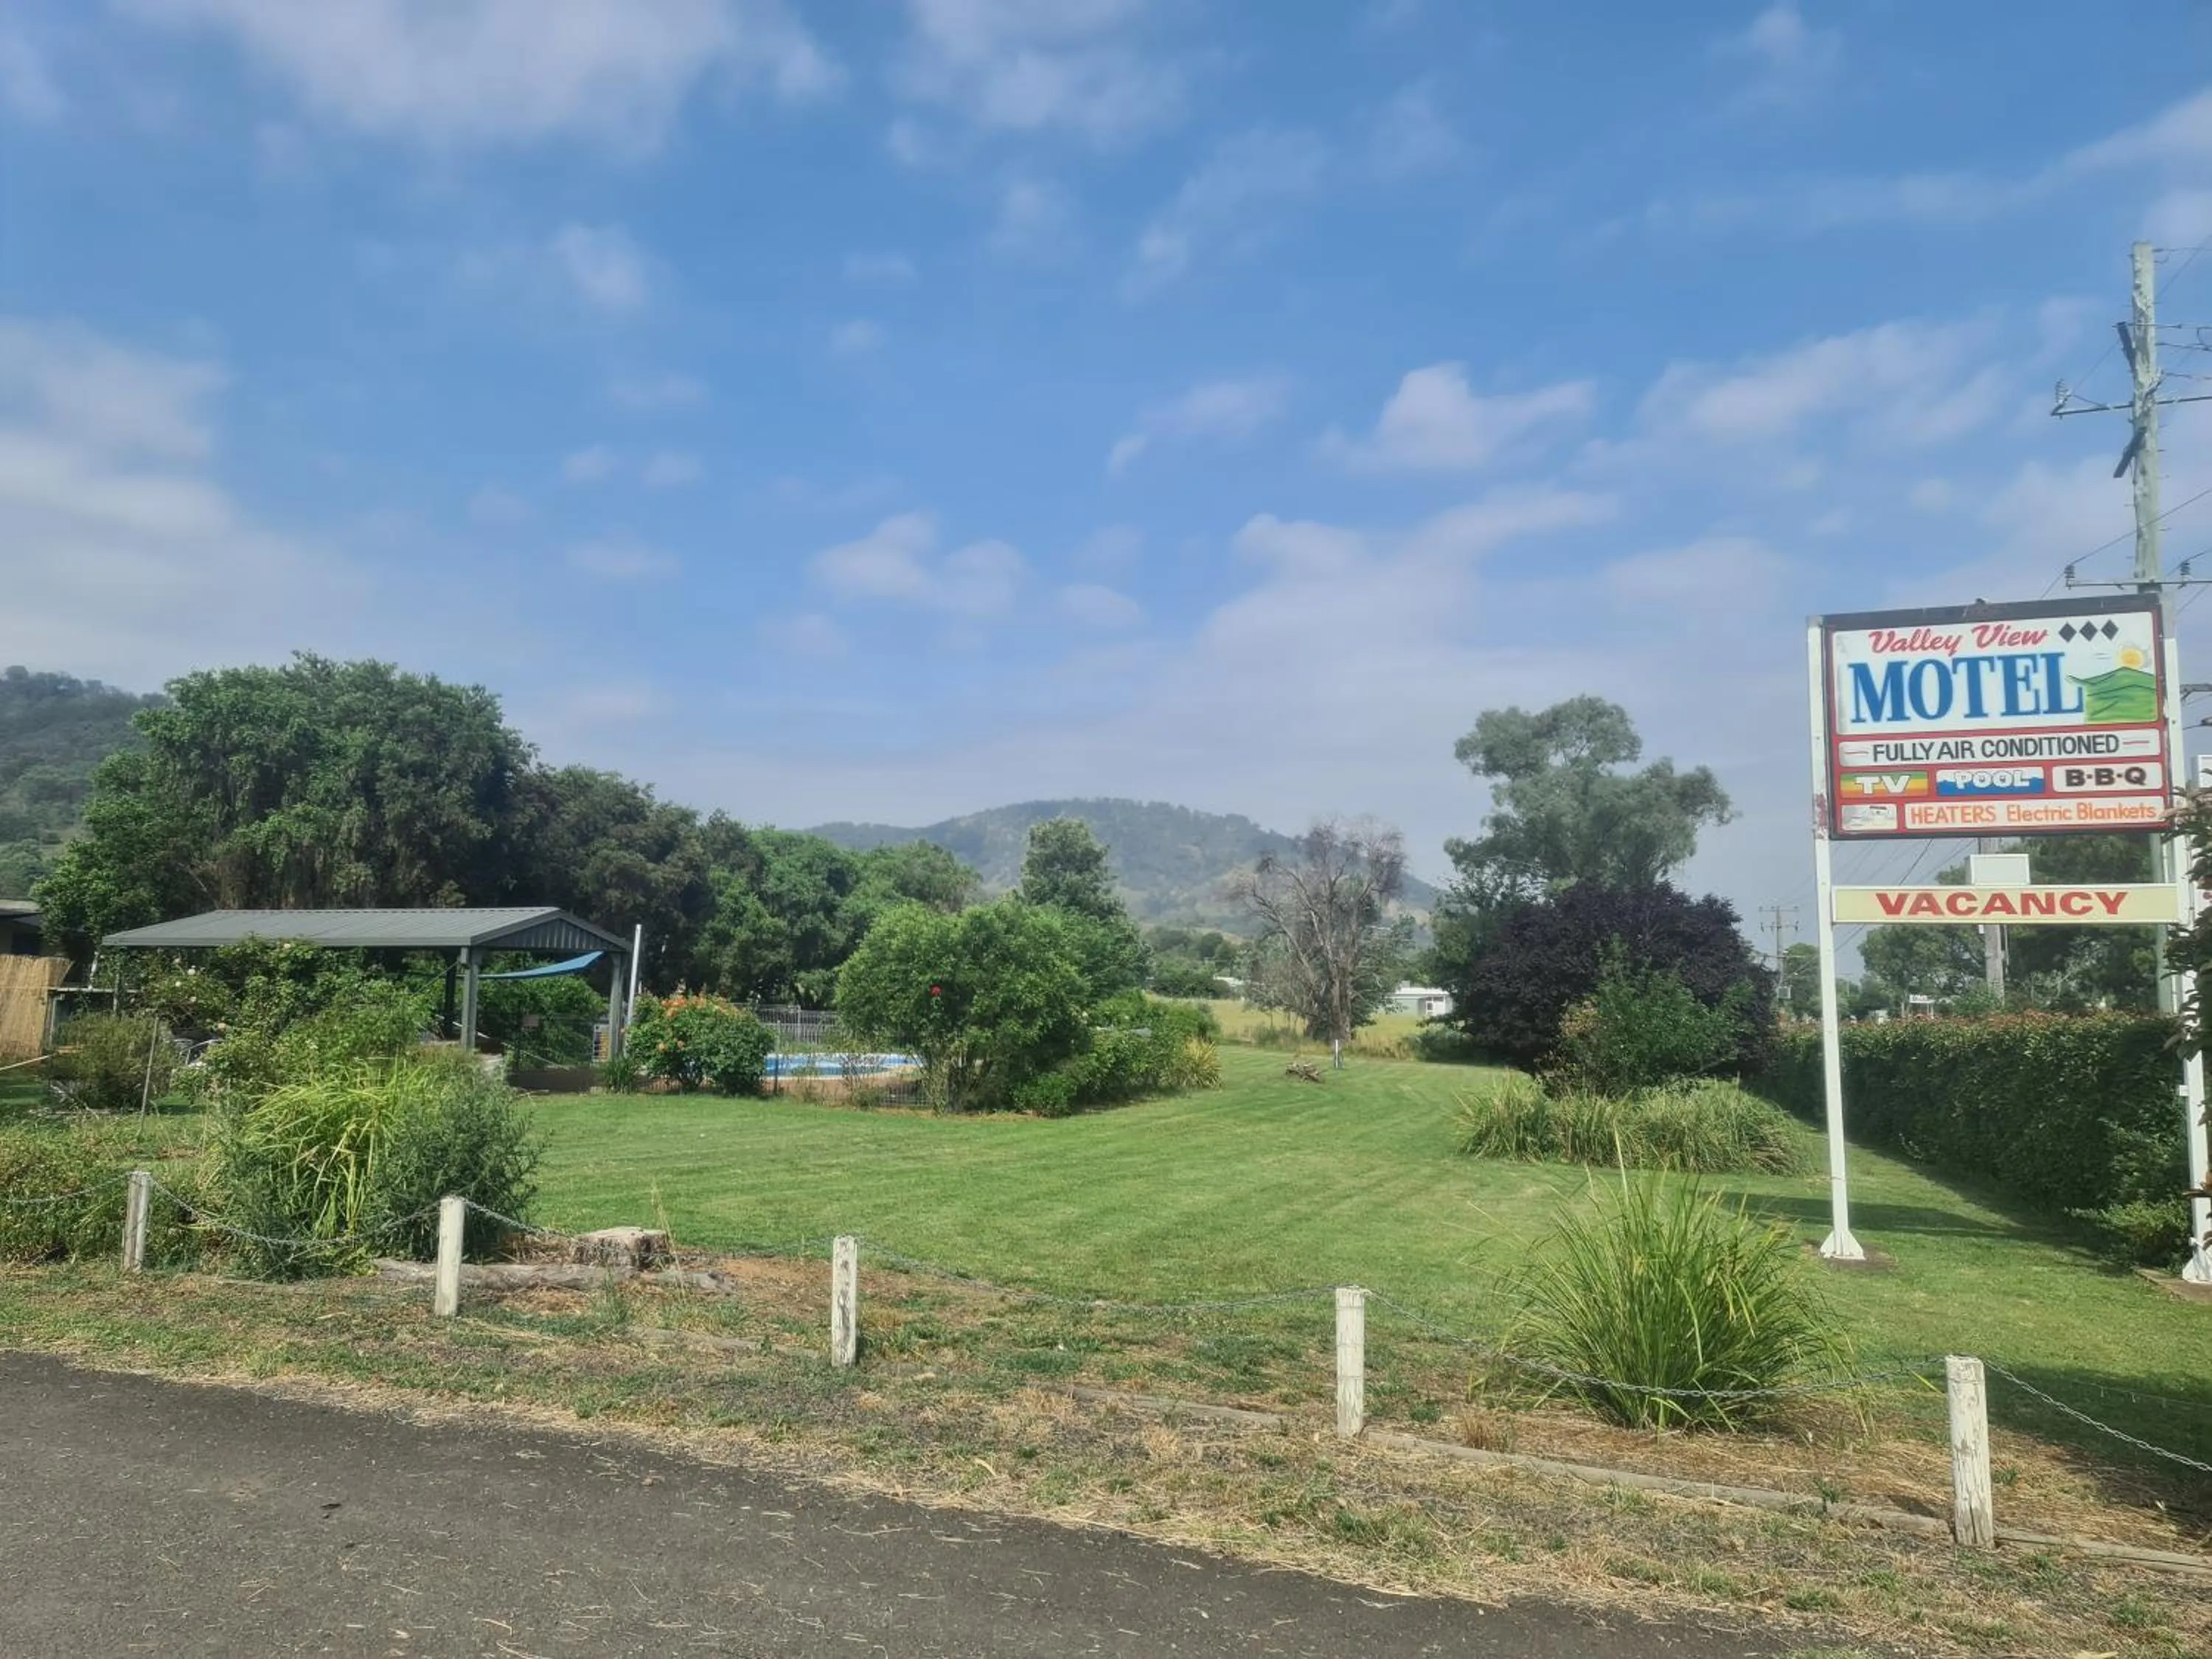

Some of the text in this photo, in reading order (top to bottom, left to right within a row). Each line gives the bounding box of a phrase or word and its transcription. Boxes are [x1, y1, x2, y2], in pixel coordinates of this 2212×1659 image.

[1868, 624, 2049, 656] Valley View
[1848, 652, 2084, 723] MOTEL
[1873, 734, 2119, 762] FULLY AIR CONDITIONED
[1856, 775, 1910, 794] TV
[1953, 770, 2030, 788] POOL
[1911, 801, 2157, 824] HEATERS Electric Blankets
[1875, 891, 2128, 916] VACANCY
